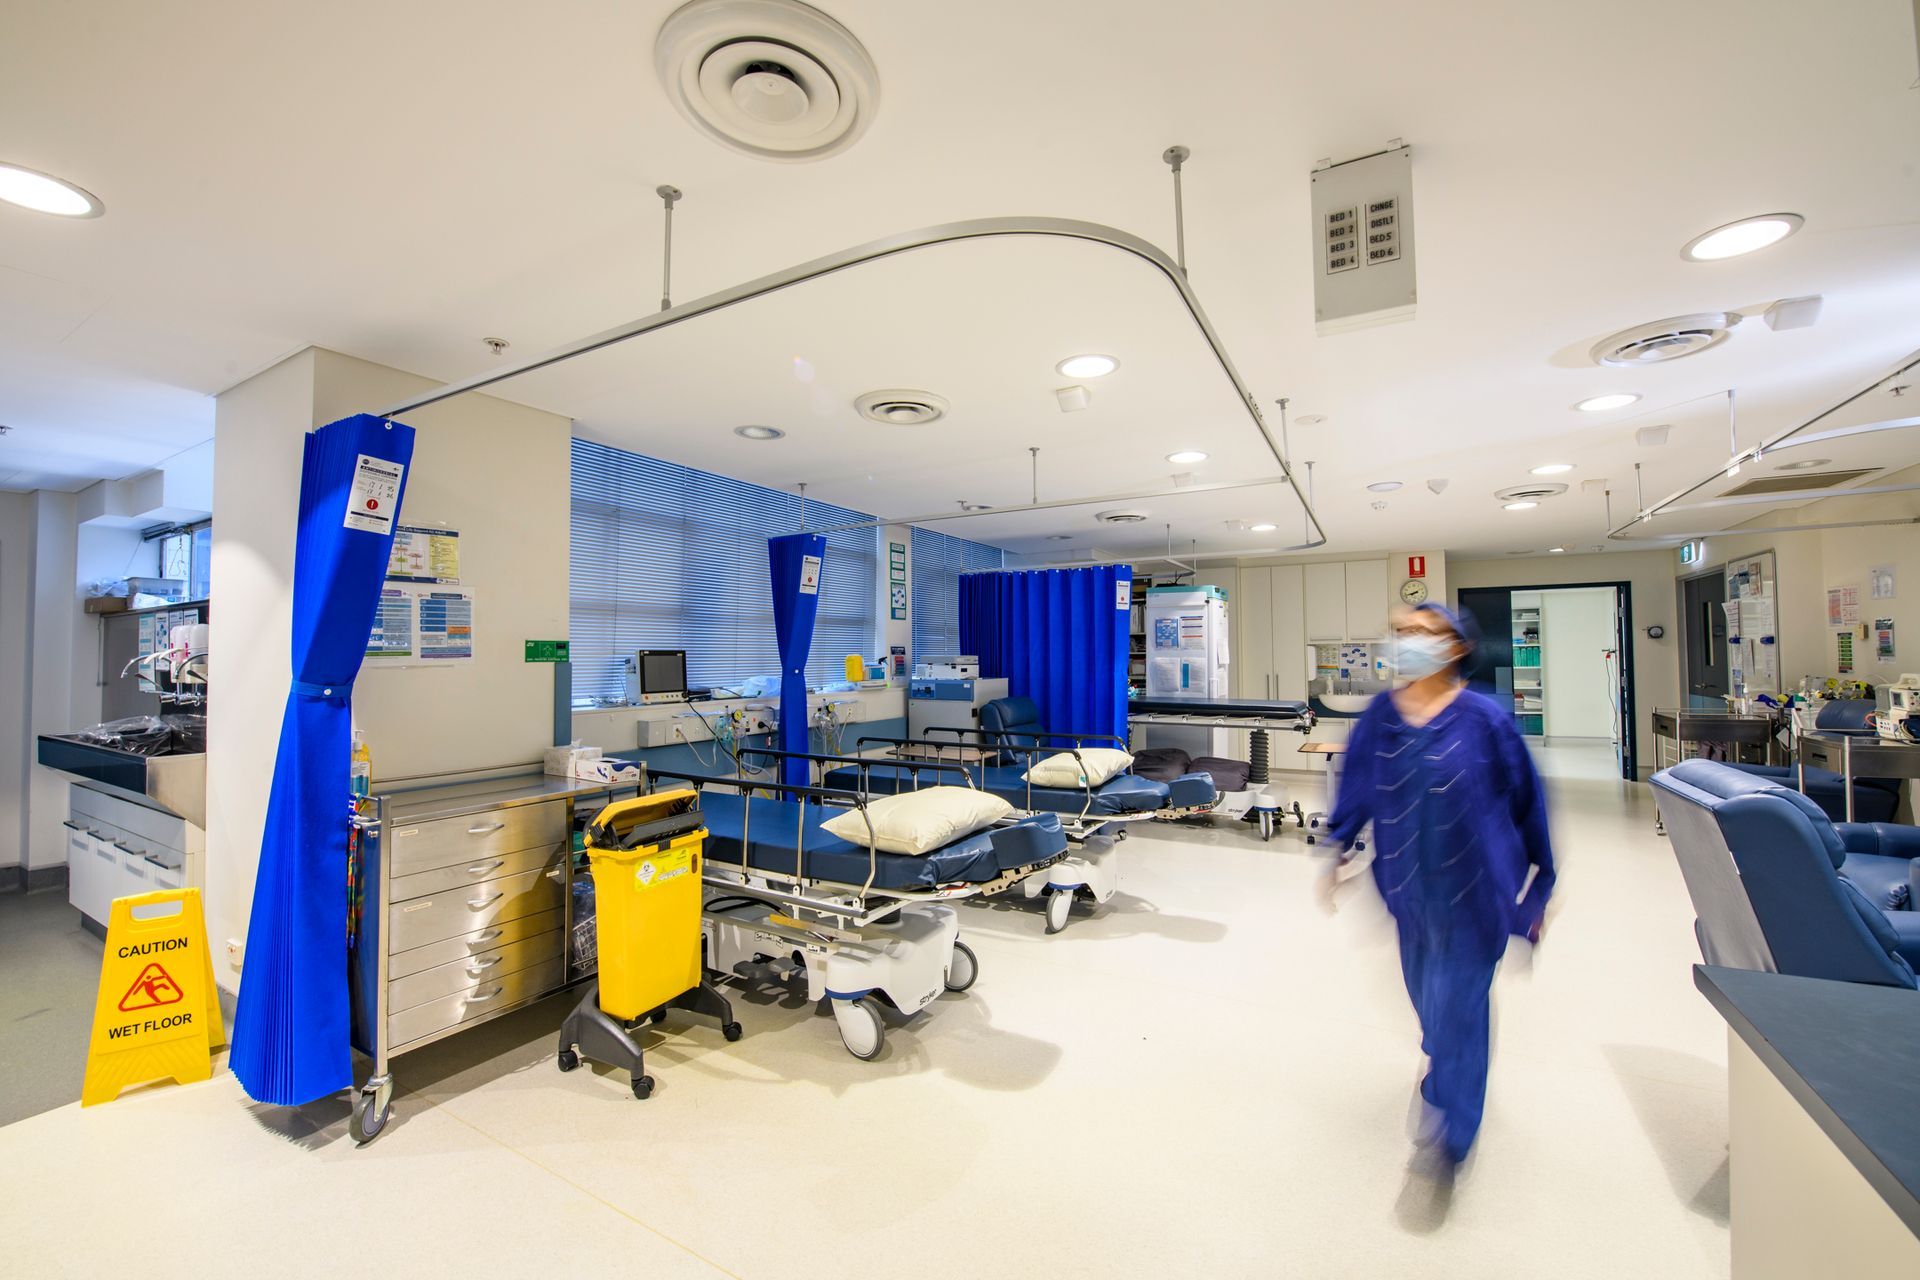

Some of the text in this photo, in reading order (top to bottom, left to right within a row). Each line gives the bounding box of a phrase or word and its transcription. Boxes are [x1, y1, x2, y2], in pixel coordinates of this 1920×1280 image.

[1330, 212, 1345, 222] BED
[1330, 225, 1353, 238] BED 2
[1370, 234, 1385, 244] BED
[1330, 242, 1345, 253] BED
[1370, 247, 1393, 259] BED 6
[1331, 258, 1345, 268] BED
[118, 937, 188, 958] CAUTION
[109, 1013, 192, 1039] WET FLOOR
